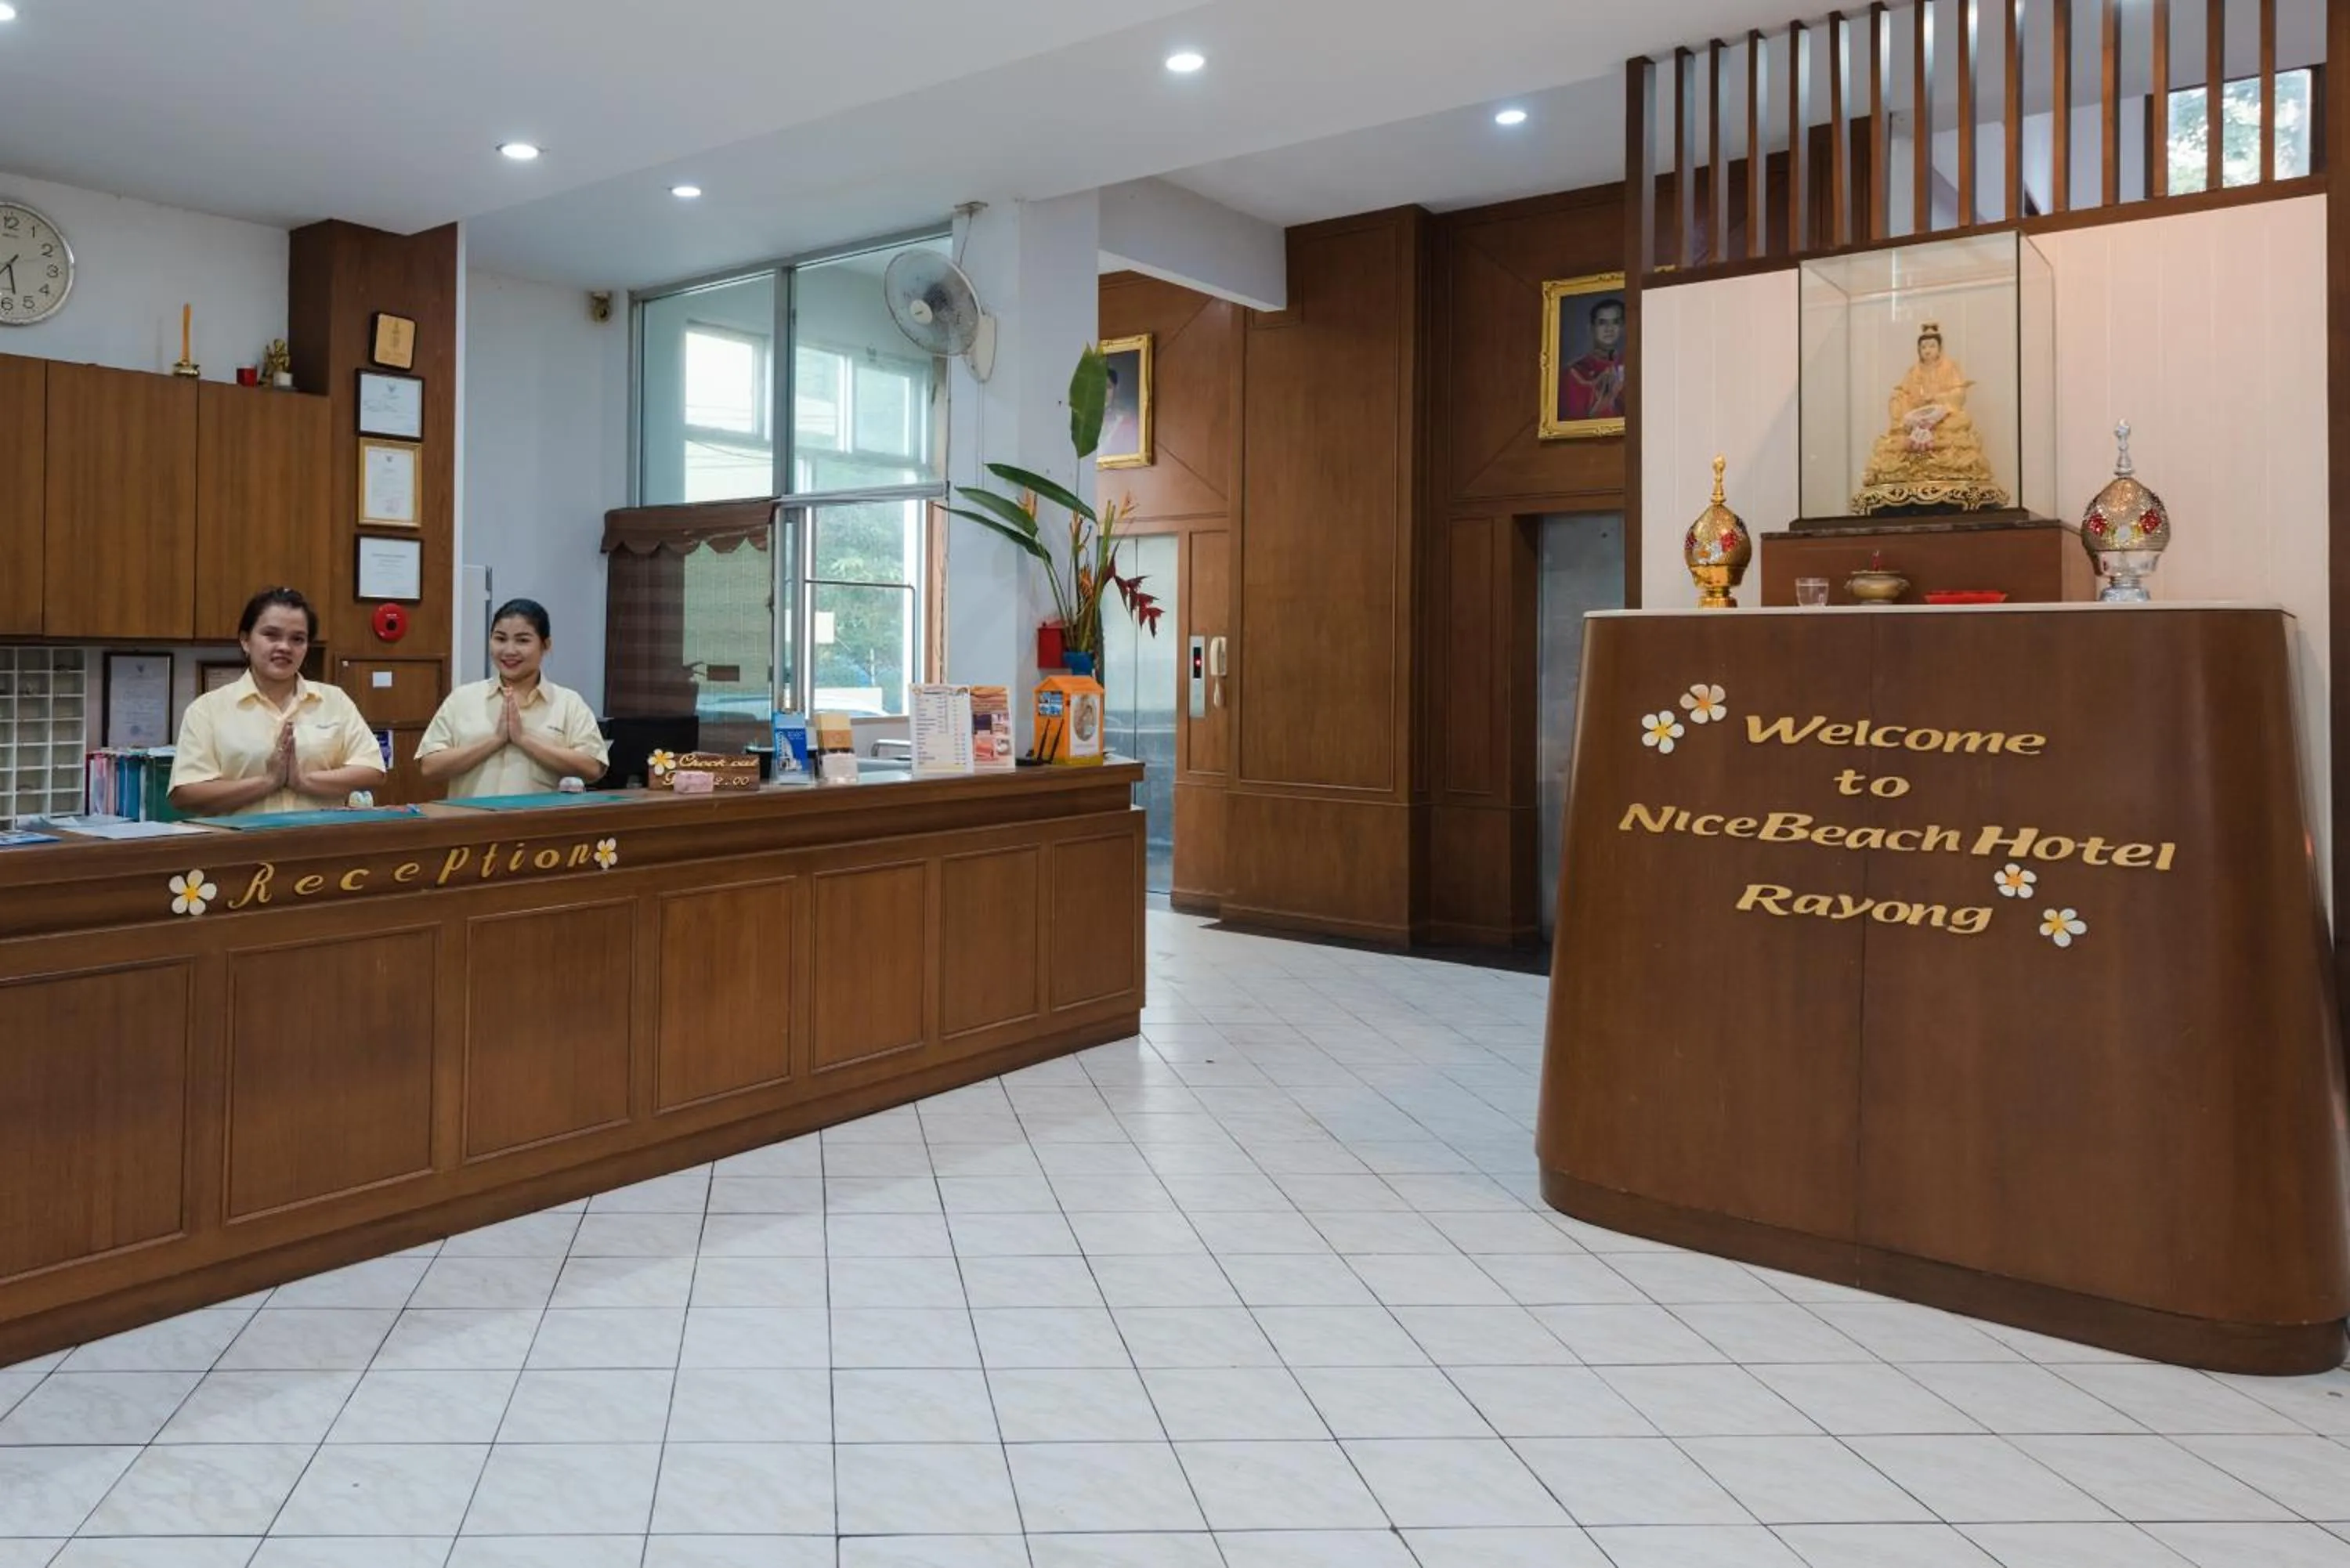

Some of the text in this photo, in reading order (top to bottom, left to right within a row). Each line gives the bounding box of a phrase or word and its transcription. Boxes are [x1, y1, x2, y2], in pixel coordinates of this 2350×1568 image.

[3, 215, 20, 230] 12
[41, 243, 53, 258] 2
[45, 263, 59, 278] 3
[38, 283, 49, 297] 4
[1, 297, 13, 312] 6
[22, 295, 35, 309] 5
[1745, 715, 2048, 755] Welcome
[714, 776, 750, 786] 2.00
[1833, 768, 1911, 798] to
[1970, 826, 2176, 871] Hotel
[227, 842, 589, 910] Reception
[1735, 883, 1994, 934] Rayong
